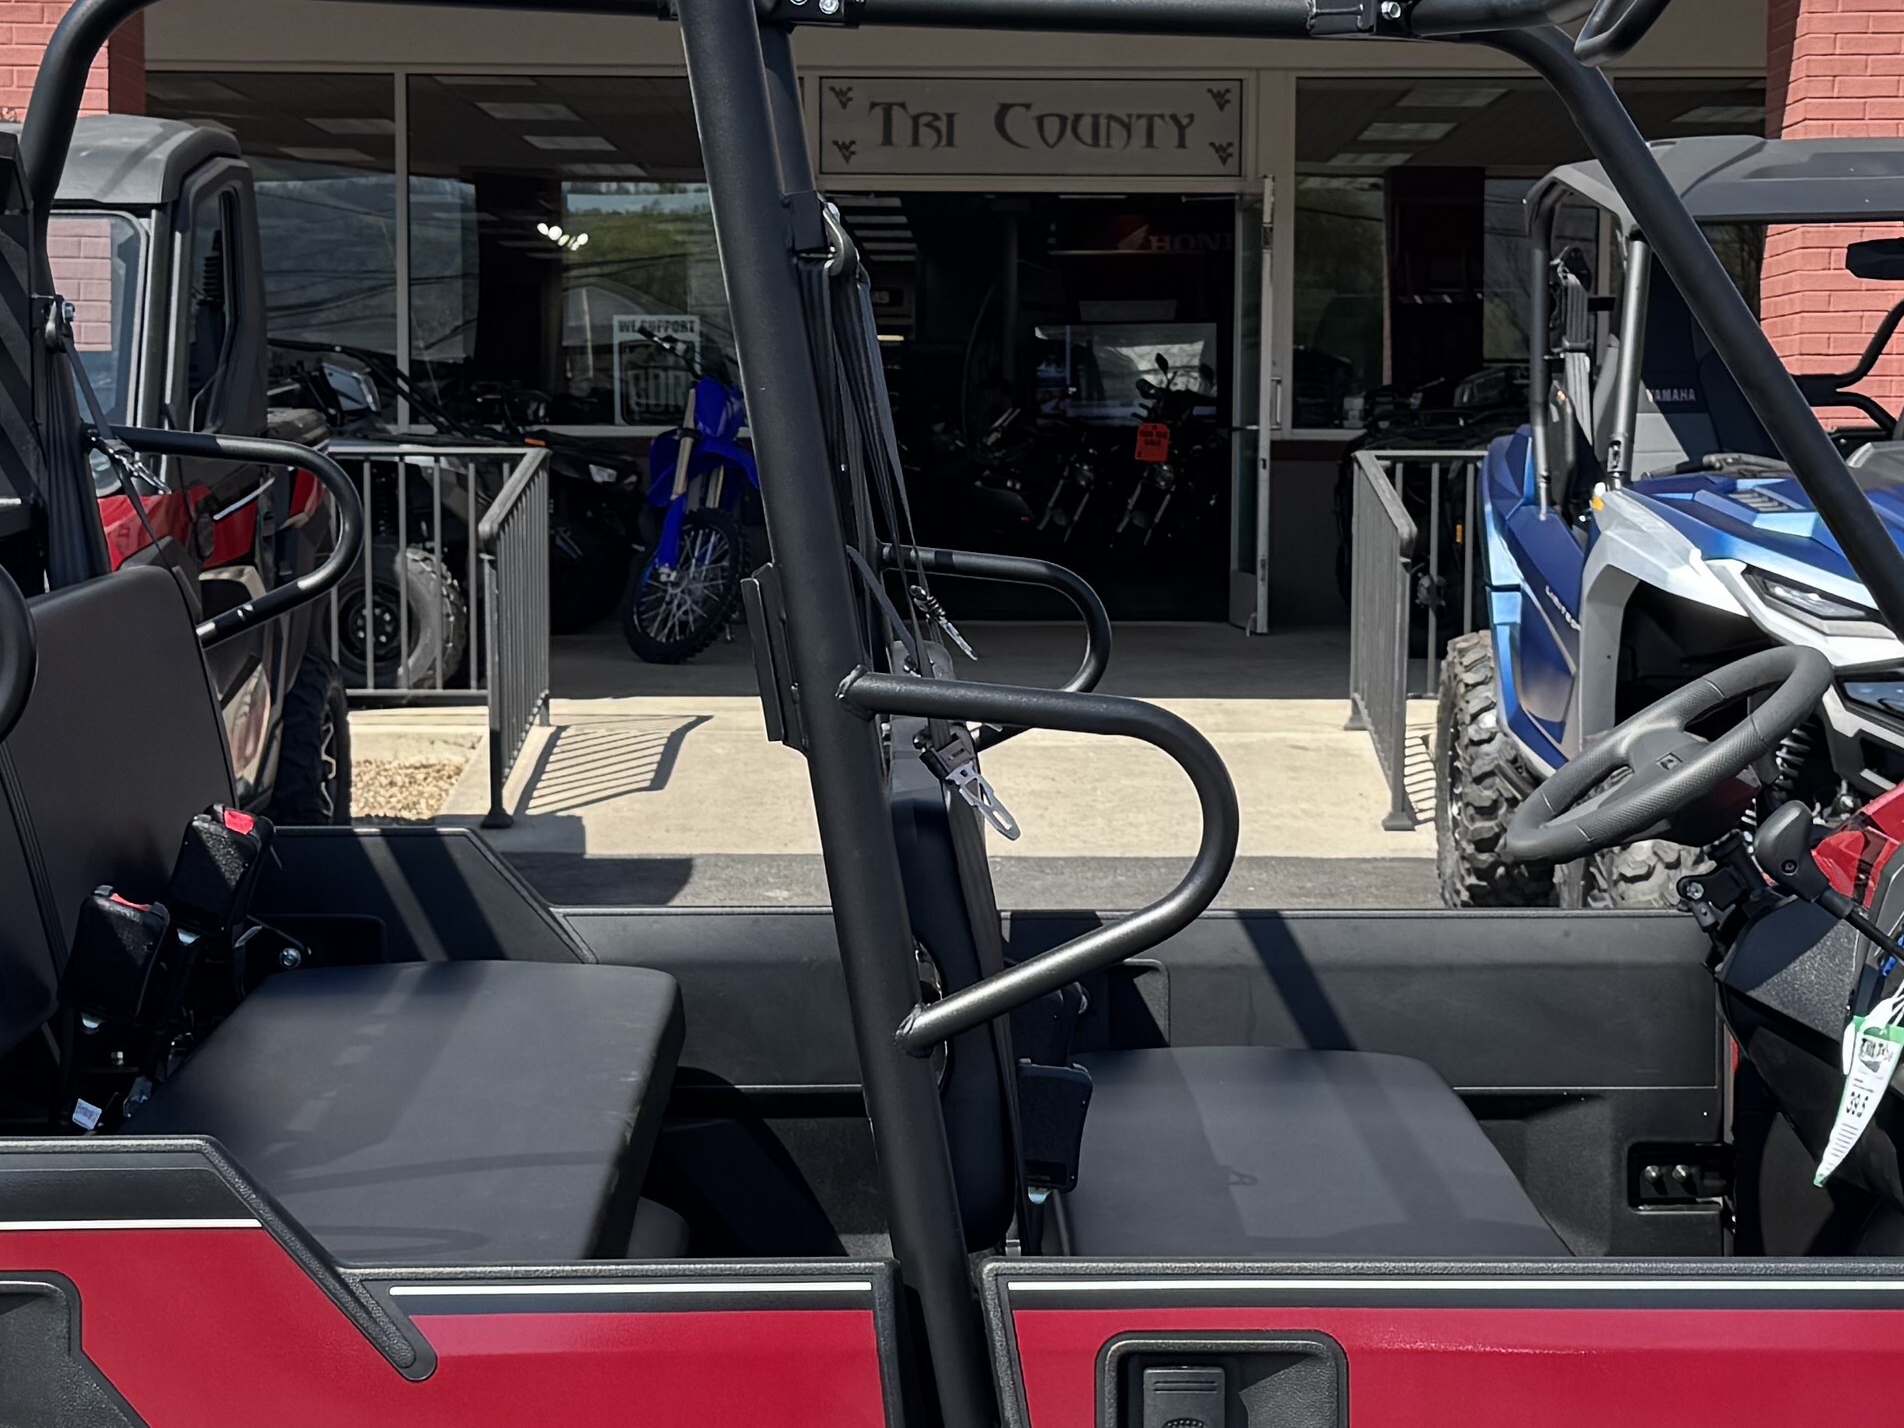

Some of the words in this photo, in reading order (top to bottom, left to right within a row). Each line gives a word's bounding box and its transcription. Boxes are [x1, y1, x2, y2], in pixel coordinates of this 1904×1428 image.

[869, 101, 960, 149] TRI
[995, 103, 1195, 151] COUNTY
[1646, 387, 1697, 403] YAMAHA
